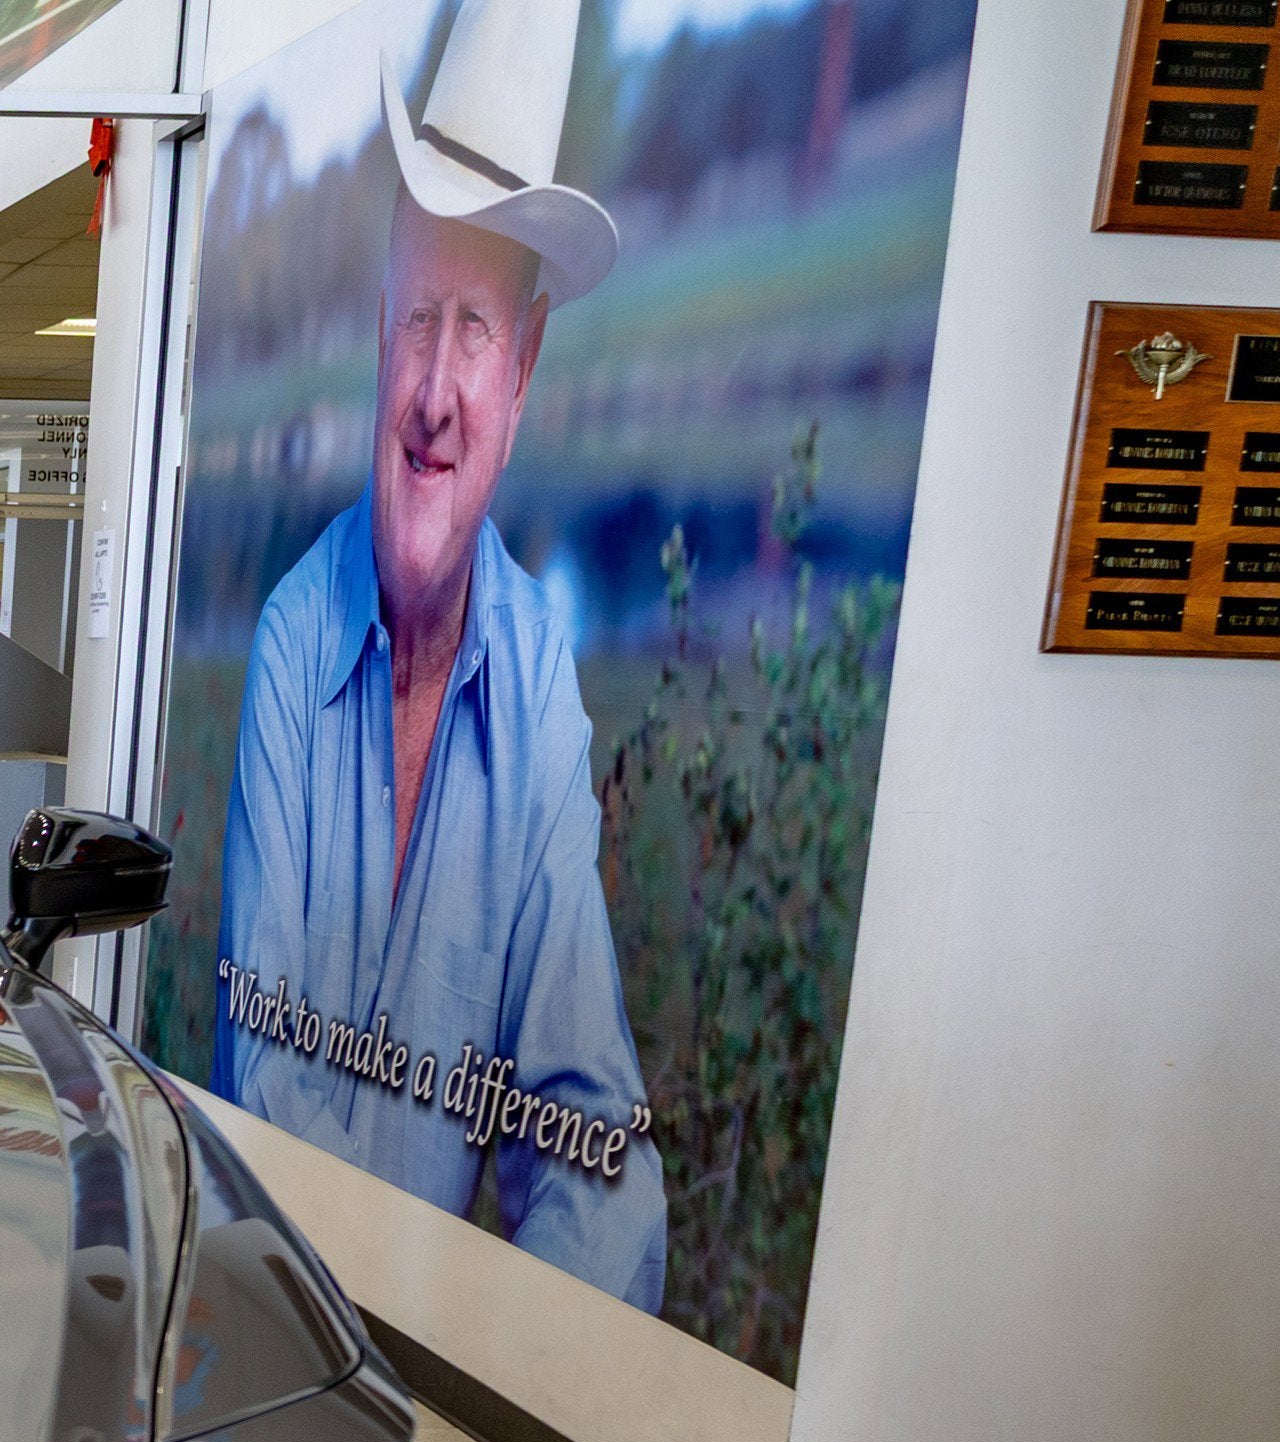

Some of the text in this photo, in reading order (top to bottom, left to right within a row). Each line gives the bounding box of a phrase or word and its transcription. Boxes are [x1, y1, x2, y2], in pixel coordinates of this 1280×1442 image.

[293, 998, 321, 1052] to
[326, 1015, 407, 1088] make
[413, 1053, 434, 1101] a
